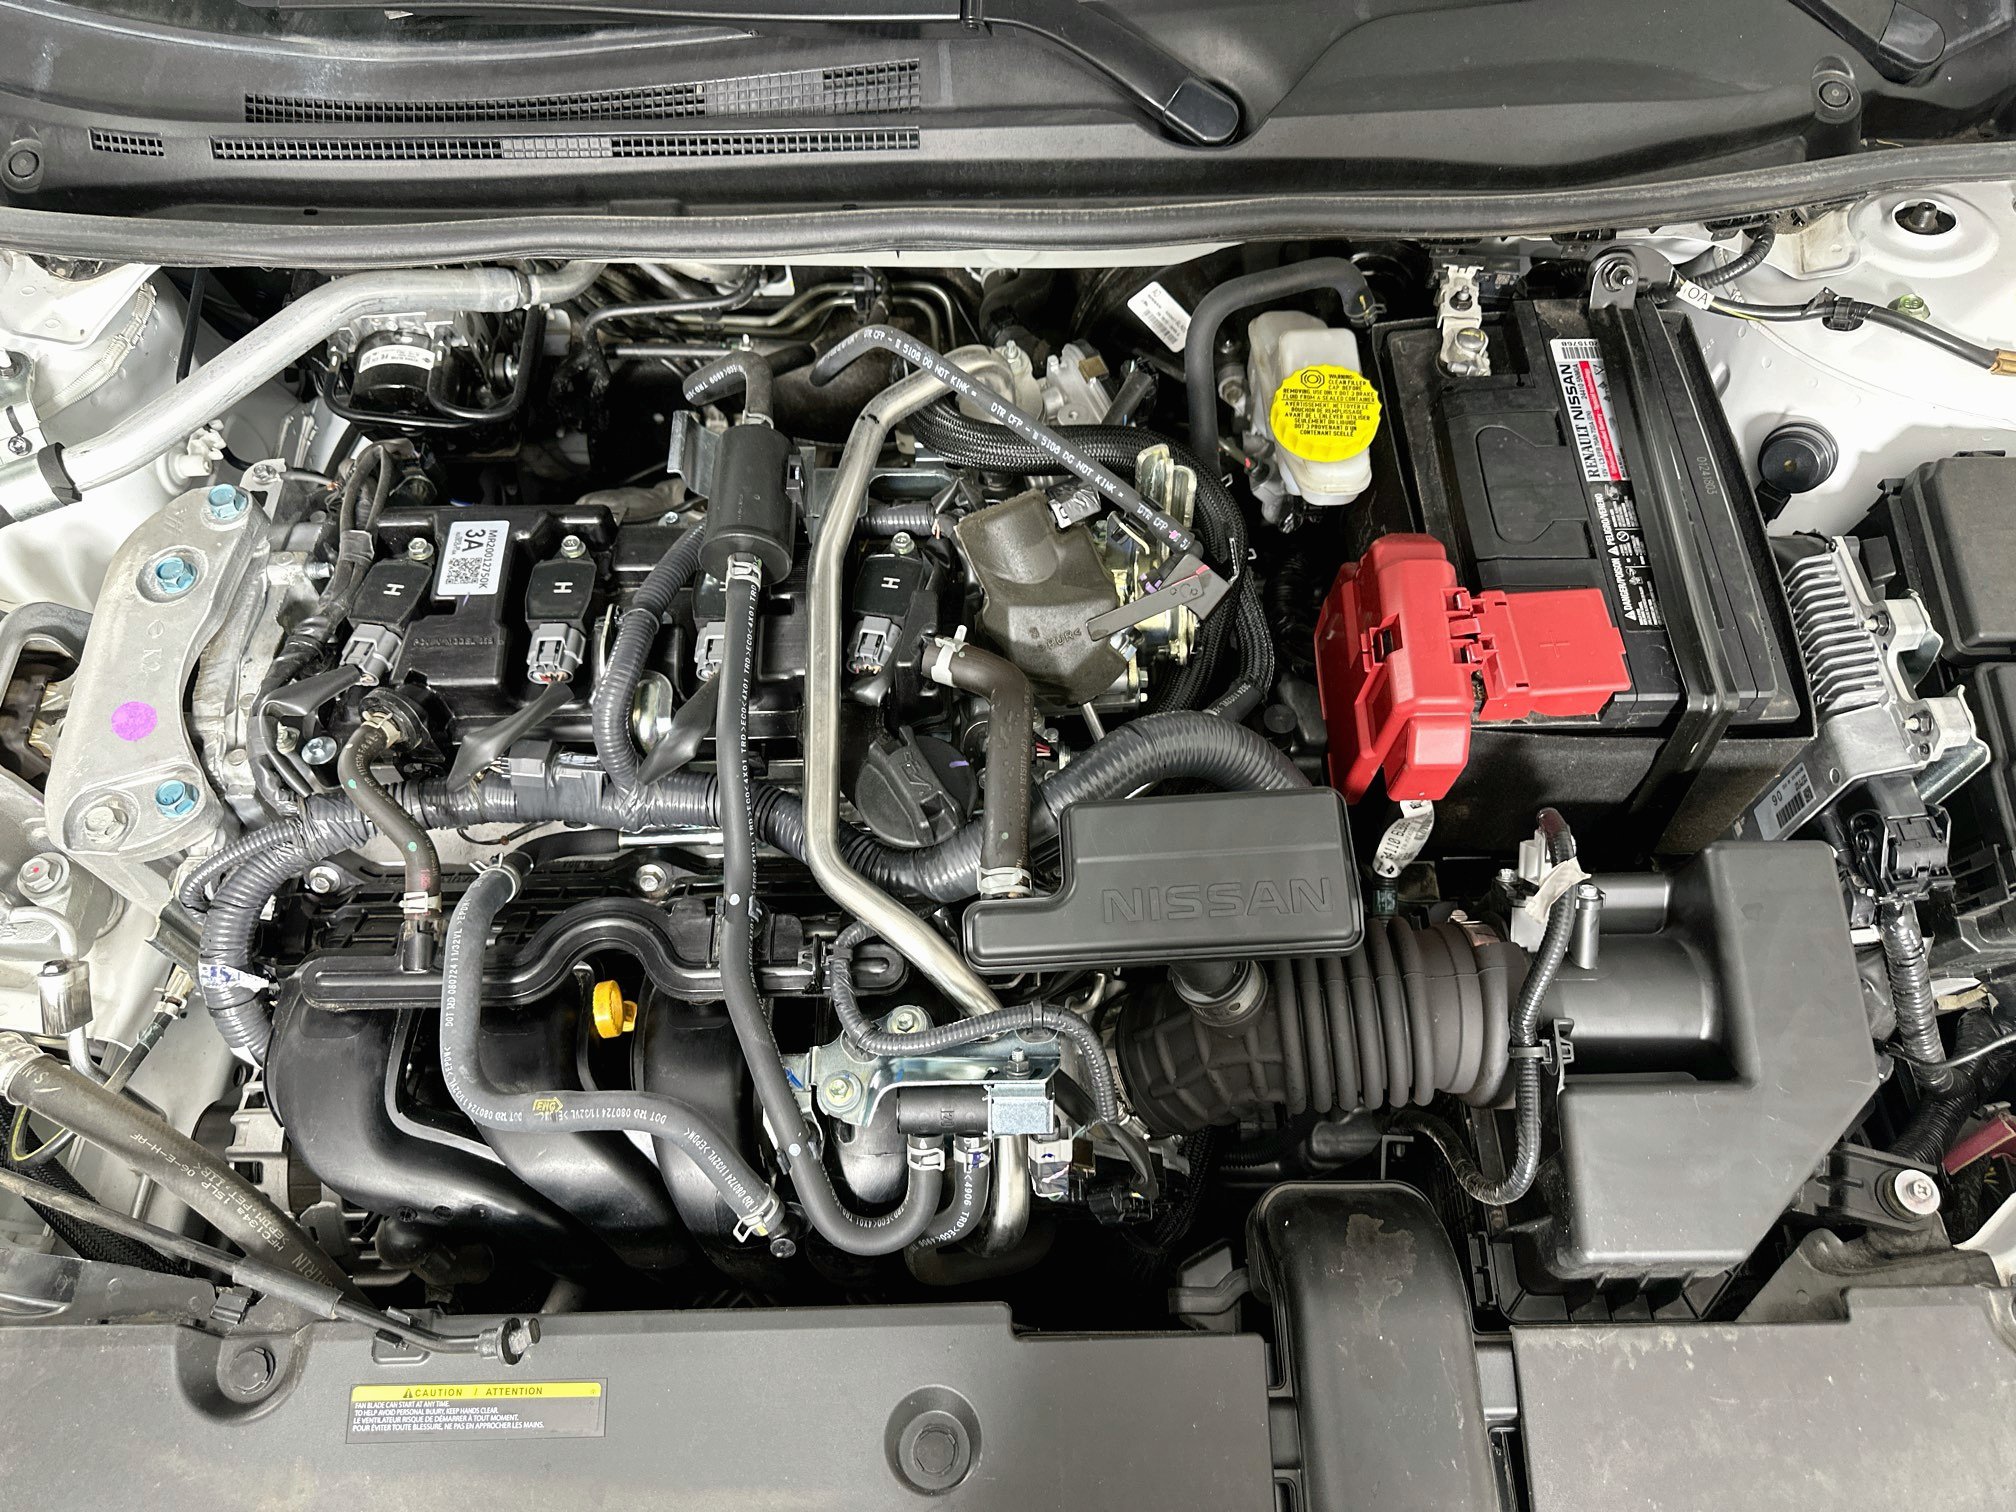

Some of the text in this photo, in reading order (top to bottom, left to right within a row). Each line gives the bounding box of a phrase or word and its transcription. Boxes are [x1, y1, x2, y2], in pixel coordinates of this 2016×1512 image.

[934, 364, 950, 380] NOT
[950, 374, 970, 394] KINK
[1559, 364, 1600, 478] RENAULT NISSAN
[990, 402, 1007, 418] DTR
[1007, 413, 1024, 428] CFP
[1076, 459, 1094, 479] NOT
[1094, 474, 1117, 494] KINK
[1153, 514, 1169, 531] CFP
[1595, 493, 1615, 546] PELIGRO/VENENO
[462, 529, 486, 552] 3A
[479, 530, 498, 589] MR20012750K
[383, 583, 404, 596] H
[553, 581, 573, 594] H
[881, 577, 900, 589] H
[1614, 557, 1633, 611] DANGER/POISON
[1771, 791, 1784, 807] 90
[1102, 876, 1334, 924] NISSAN
[445, 1012, 456, 1028] DOT
[602, 1108, 631, 1119] 080724
[650, 1112, 667, 1124] DOT
[130, 1132, 196, 1177] 06-E-H-AF
[724, 1173, 747, 1197] 080724
[238, 1206, 285, 1252] HFC134a
[415, 1388, 462, 1397] CAUTION
[486, 1387, 543, 1396] ATTENTION
[434, 1414, 467, 1422] DÉMARRER
